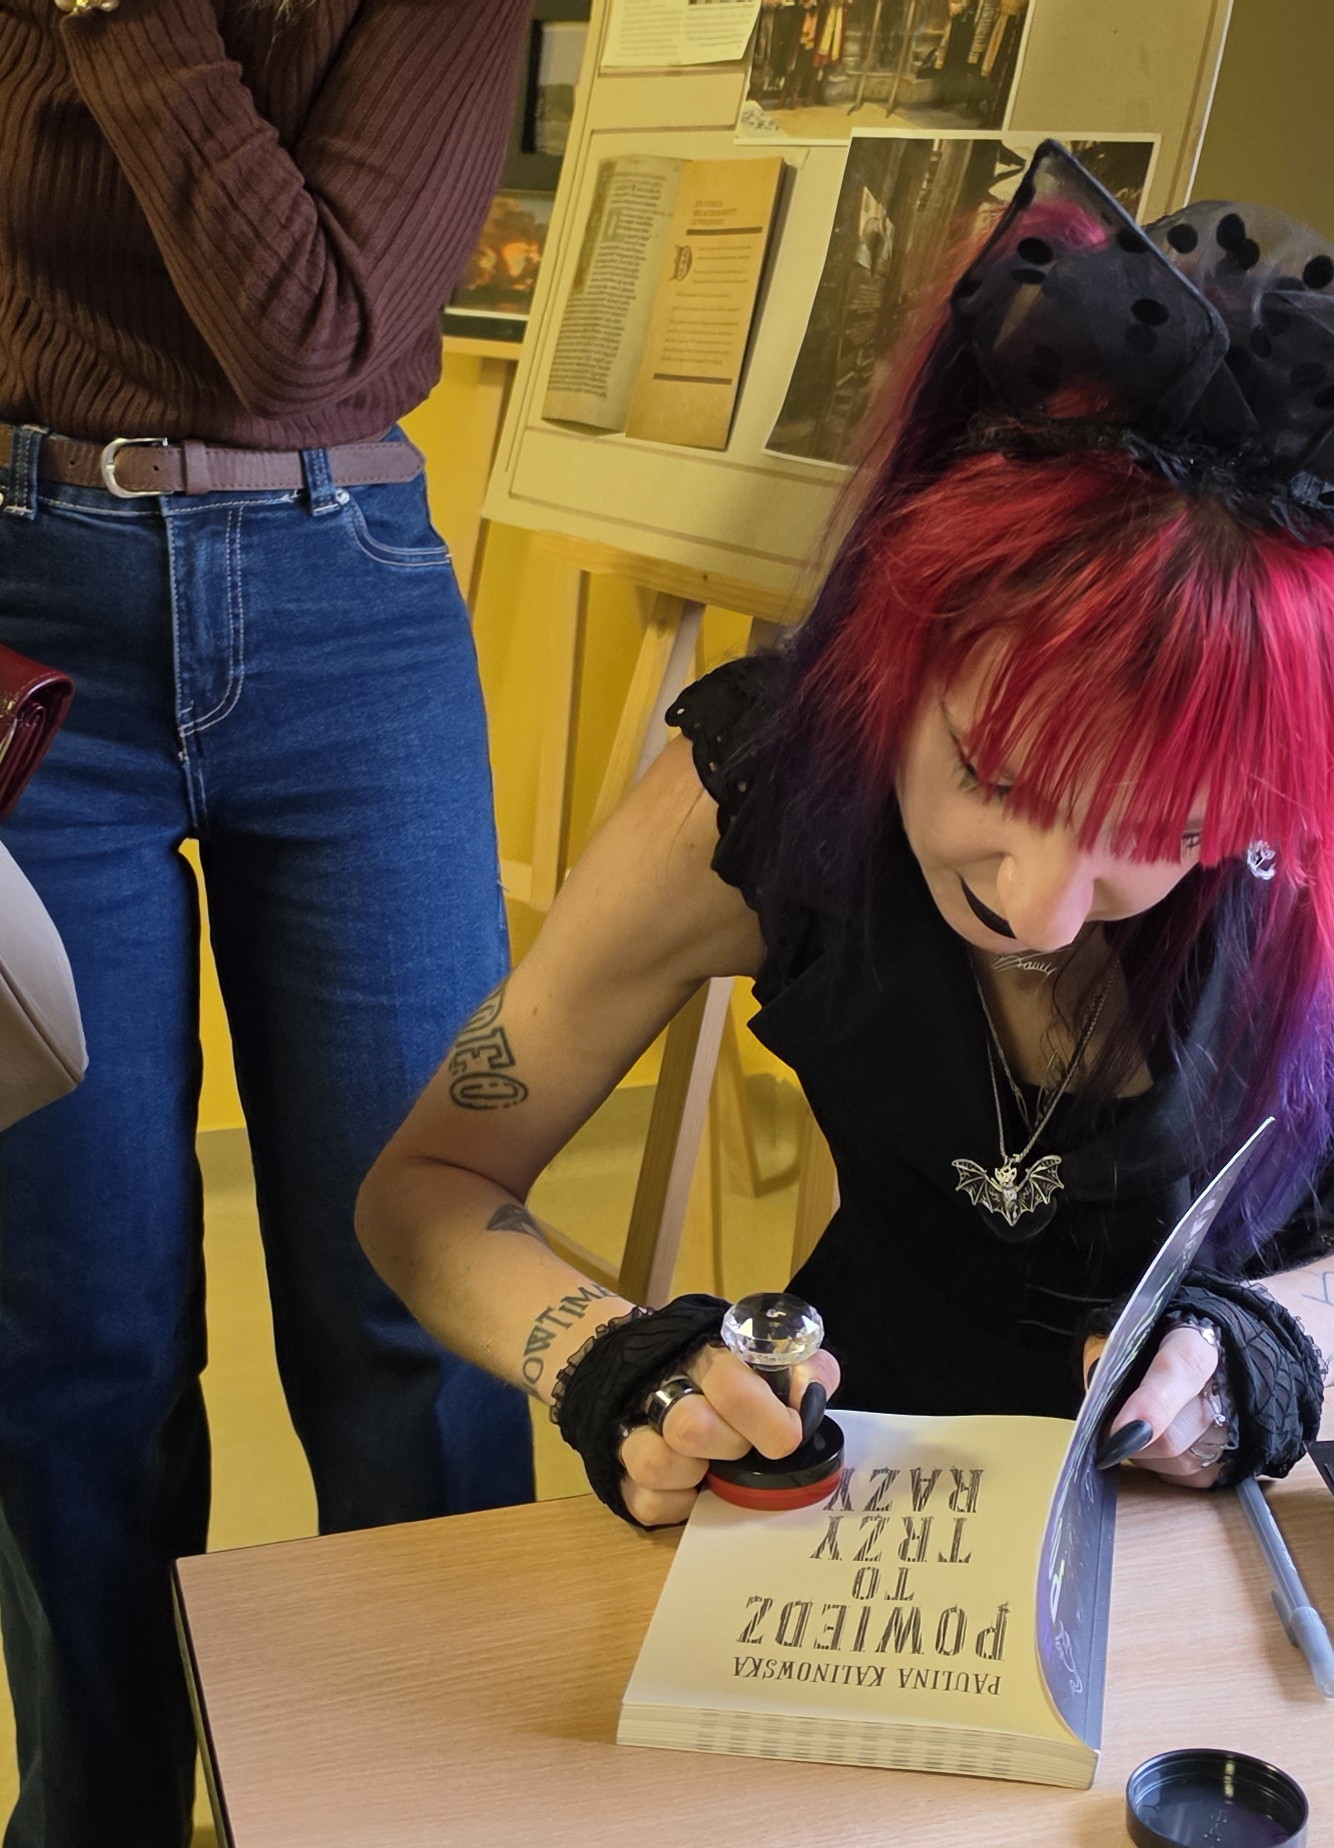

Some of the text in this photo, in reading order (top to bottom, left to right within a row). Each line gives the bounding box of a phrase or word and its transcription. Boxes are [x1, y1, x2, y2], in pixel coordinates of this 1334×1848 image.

[822, 1467, 985, 1514] RAZY
[809, 1514, 973, 1564] TRZY
[851, 1565, 916, 1601] TO
[735, 1594, 1011, 1662] POWIEDZ
[731, 1655, 1003, 1696] PAULINA KALINOWSKA
